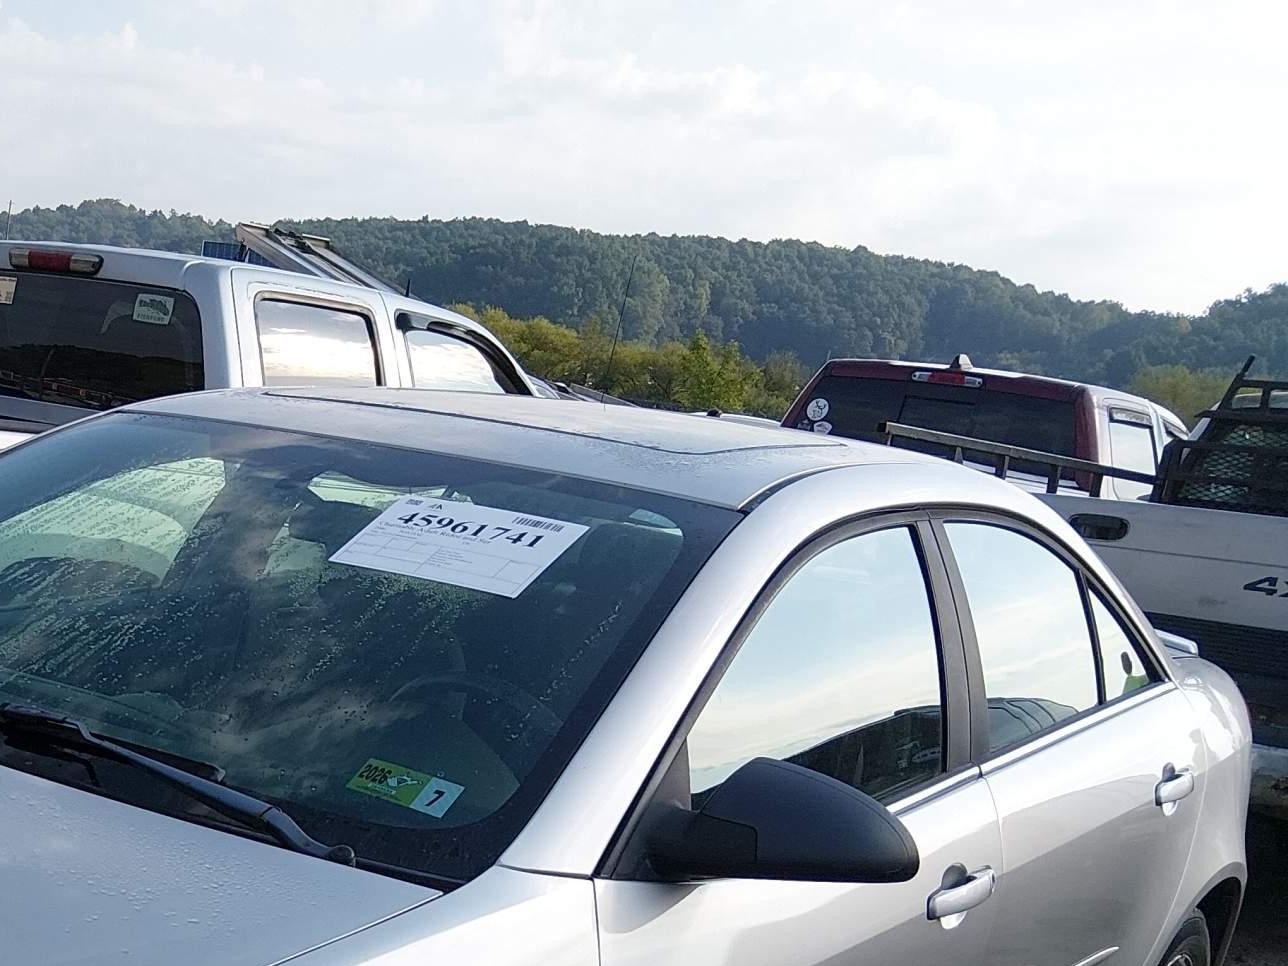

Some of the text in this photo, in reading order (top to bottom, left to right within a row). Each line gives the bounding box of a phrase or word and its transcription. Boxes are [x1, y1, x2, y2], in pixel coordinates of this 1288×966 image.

[397, 512, 544, 547] 45961741
[359, 764, 392, 784] 2026
[425, 789, 446, 806] 7
